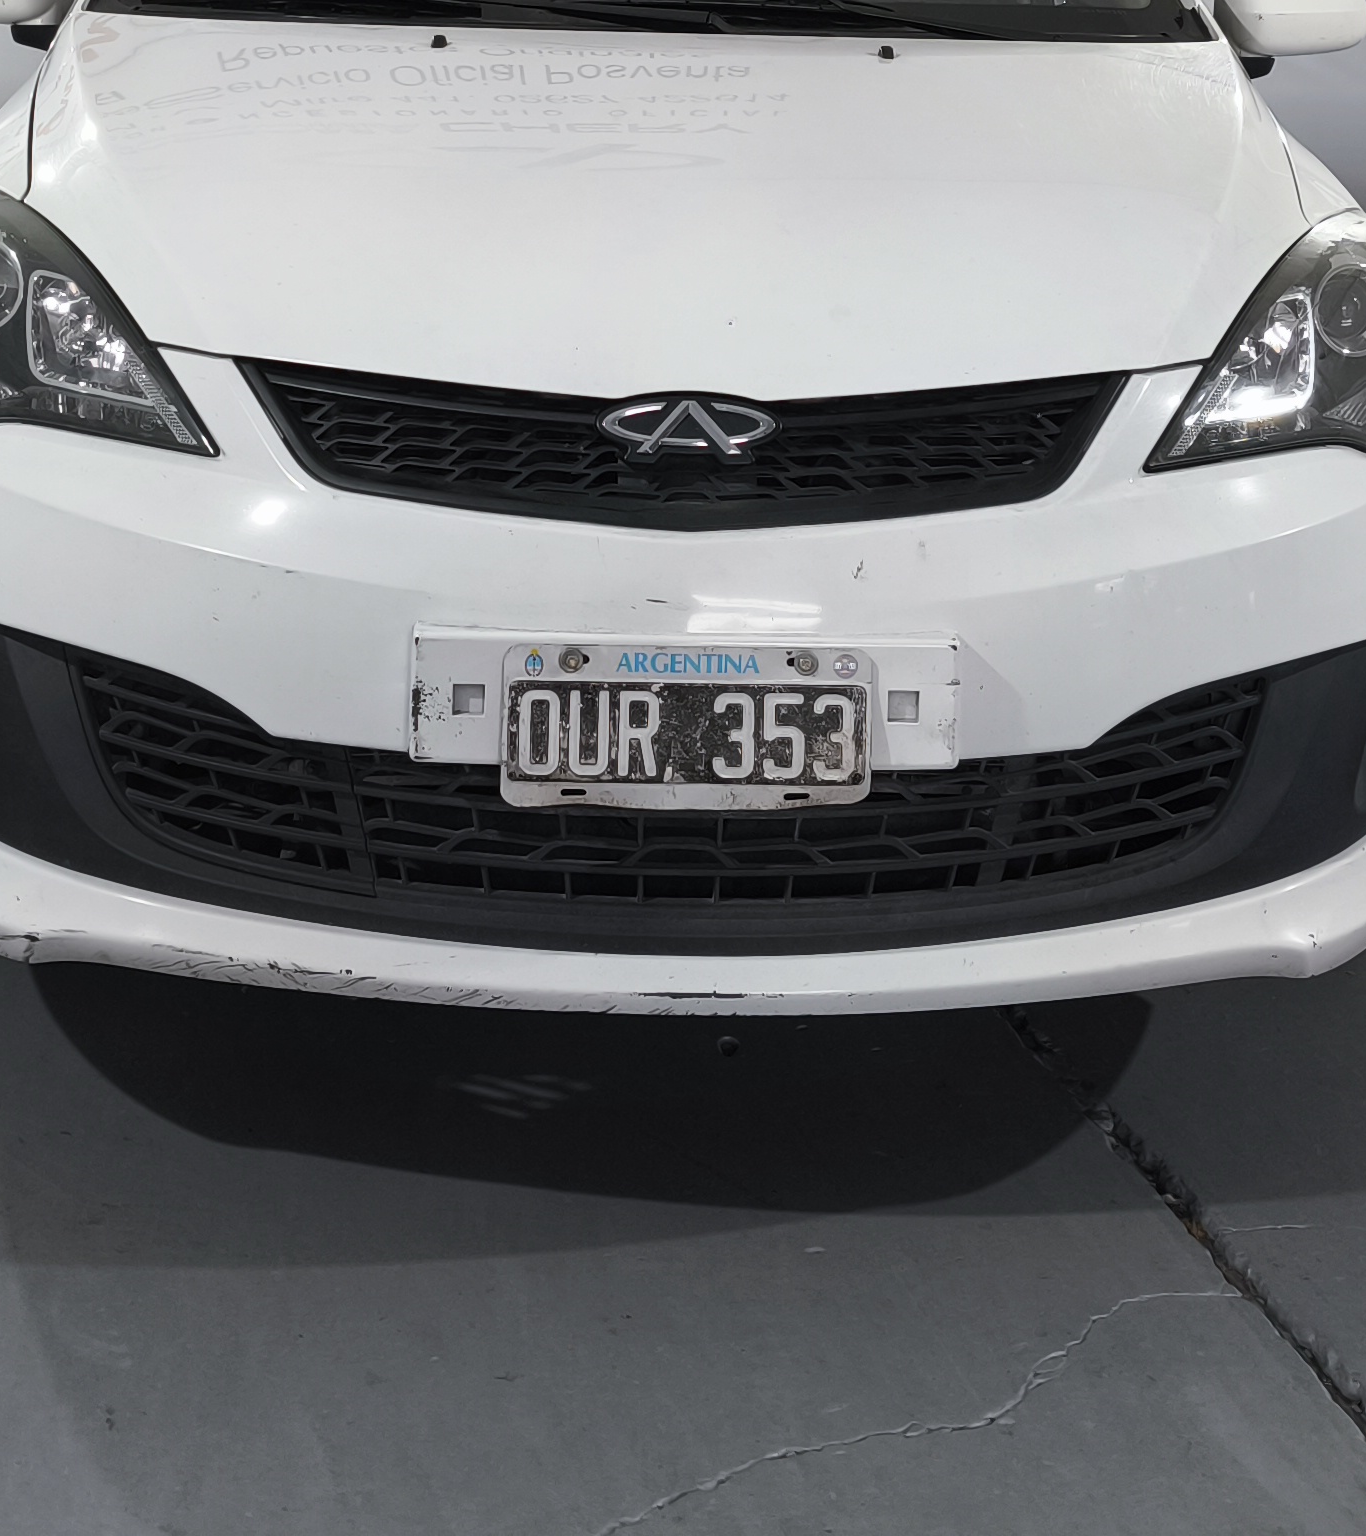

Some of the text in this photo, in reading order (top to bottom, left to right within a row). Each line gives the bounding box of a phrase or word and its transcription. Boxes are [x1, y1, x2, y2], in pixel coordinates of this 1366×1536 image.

[615, 651, 760, 676] ARGENTINA
[518, 688, 857, 781] OUR 353
